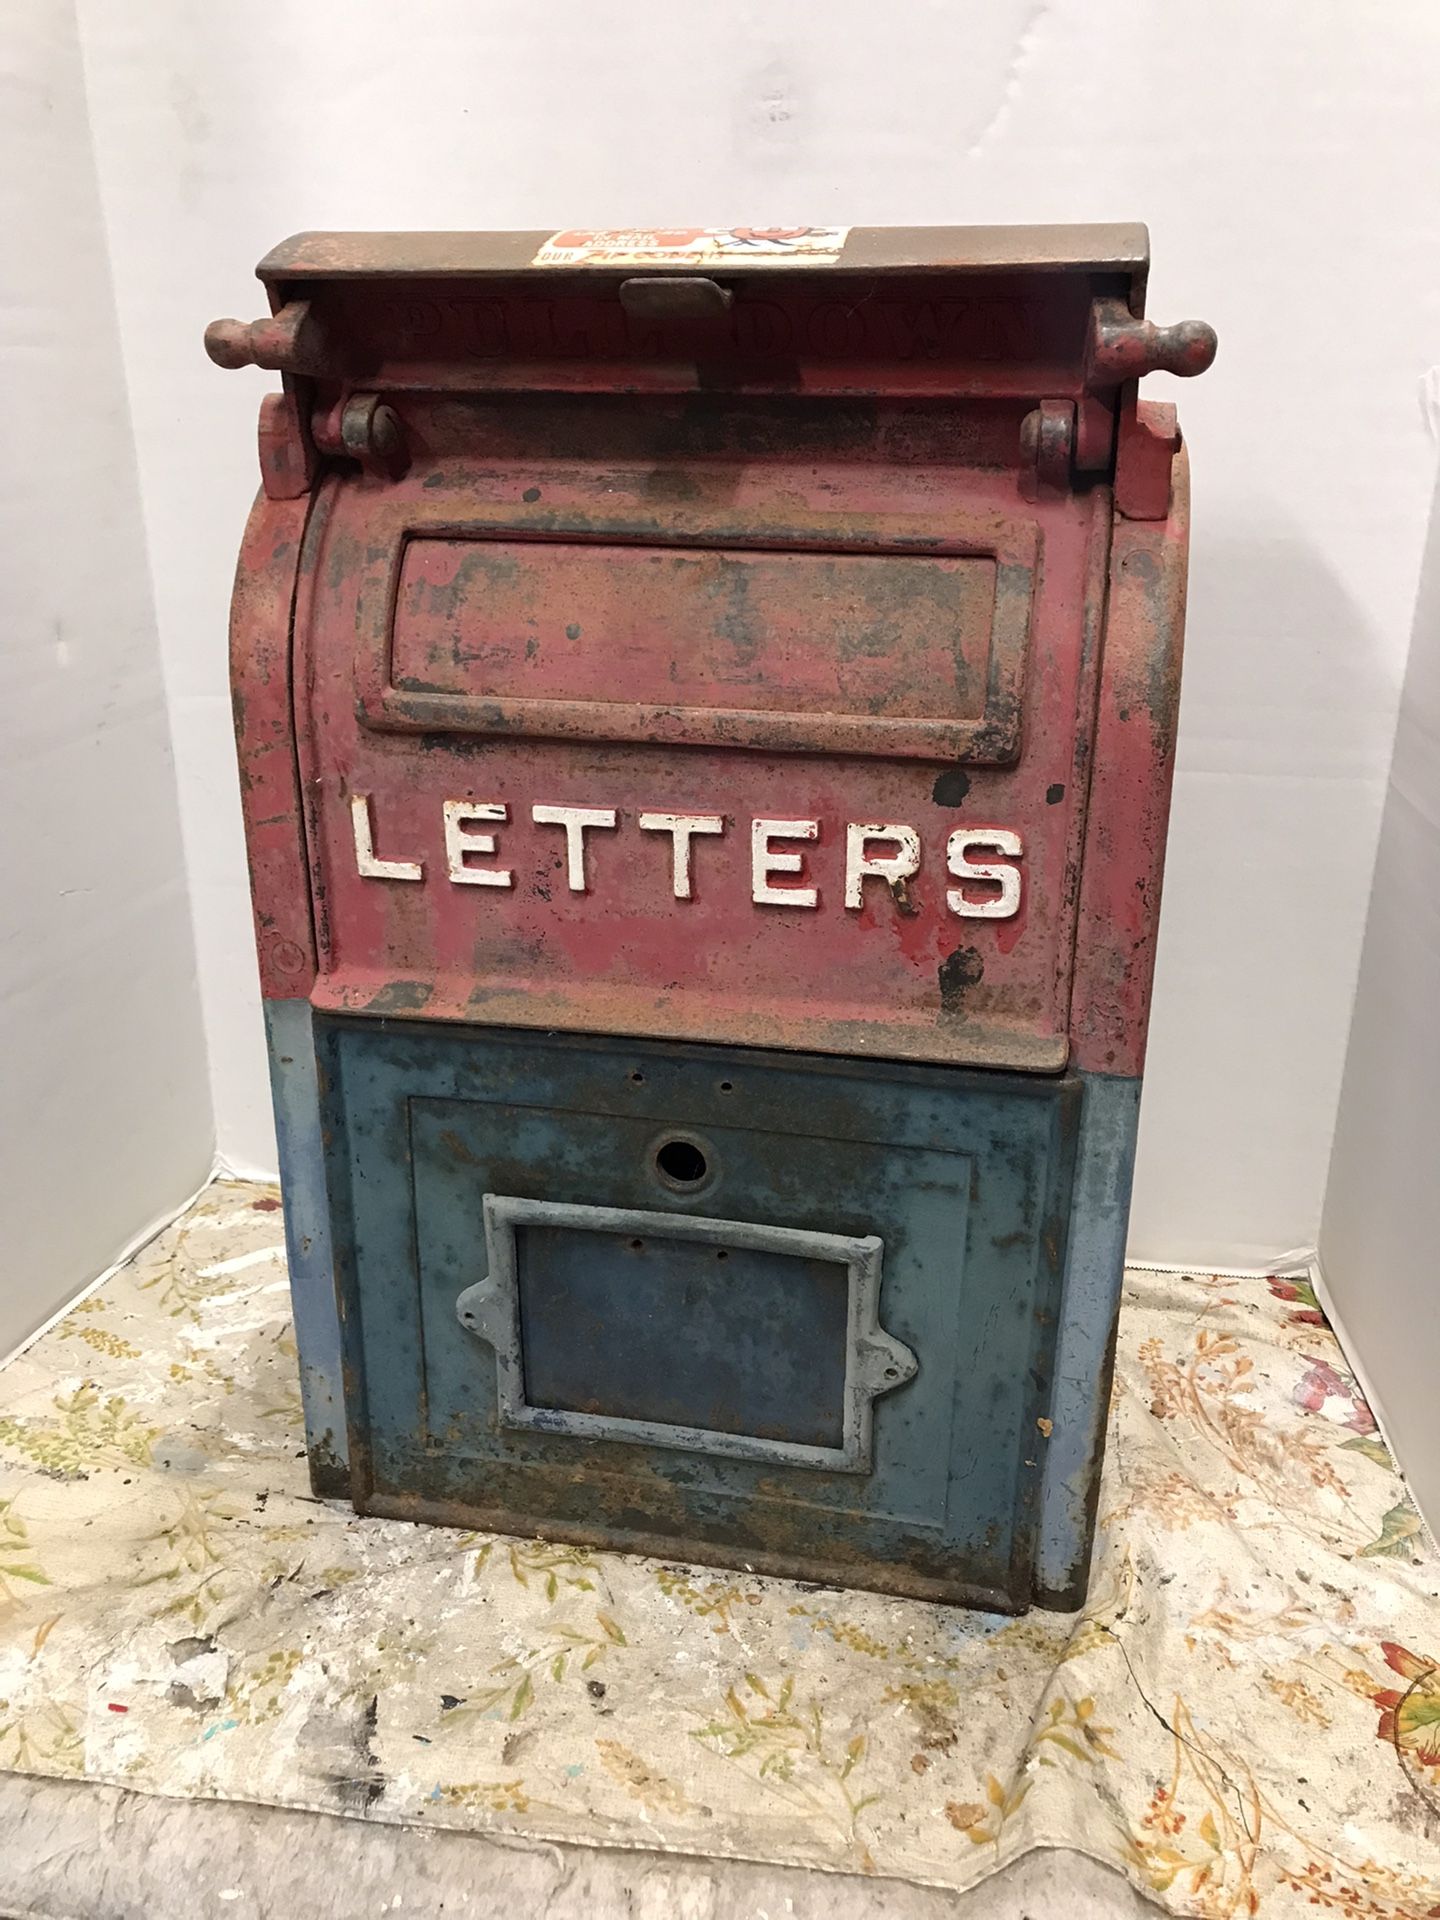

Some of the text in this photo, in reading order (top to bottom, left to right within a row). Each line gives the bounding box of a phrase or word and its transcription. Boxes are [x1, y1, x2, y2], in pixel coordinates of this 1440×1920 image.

[540, 251, 575, 261] OUR
[573, 249, 628, 265] ZIP
[634, 250, 697, 260] CODE
[582, 240, 660, 248] ADDRESS
[731, 299, 1047, 361] DOWN
[351, 794, 1024, 919] LETTERS
